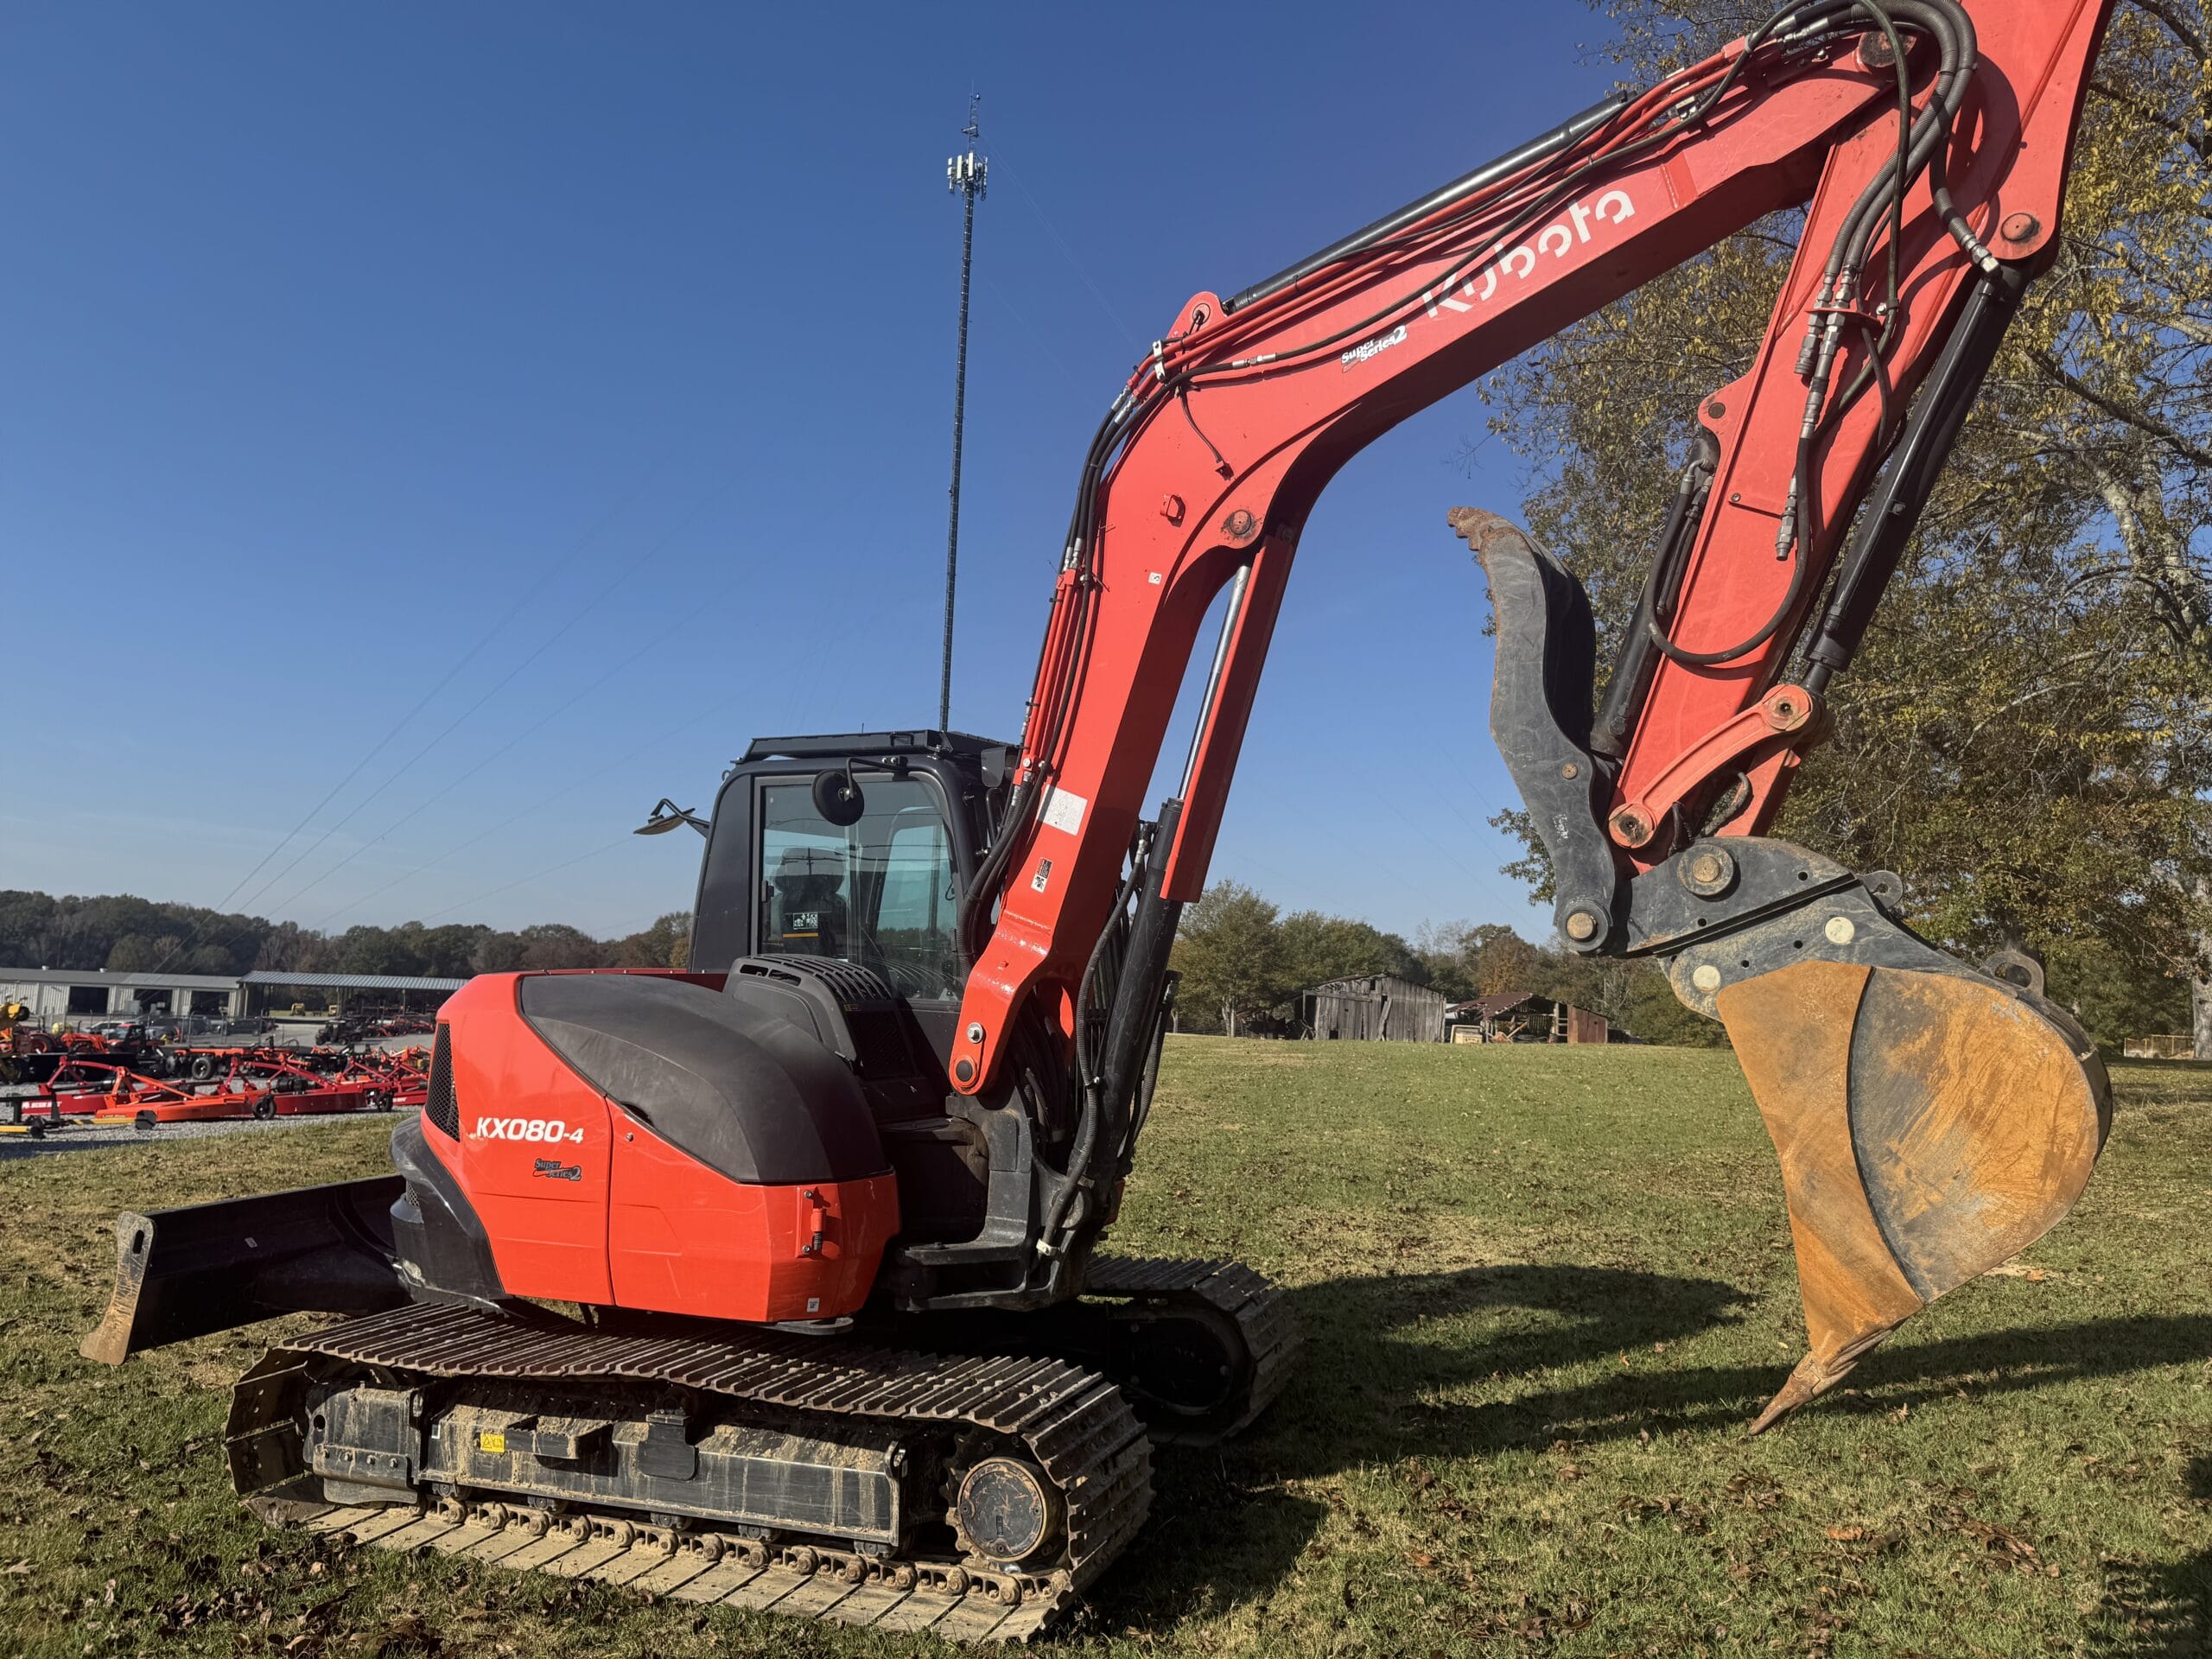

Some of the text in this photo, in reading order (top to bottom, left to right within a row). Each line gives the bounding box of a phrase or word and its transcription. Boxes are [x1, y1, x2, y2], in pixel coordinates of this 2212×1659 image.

[1421, 189, 1636, 319] Kubota
[1341, 339, 1376, 365] Super
[476, 1116, 585, 1144] KX080-4
[535, 1158, 562, 1171] Super
